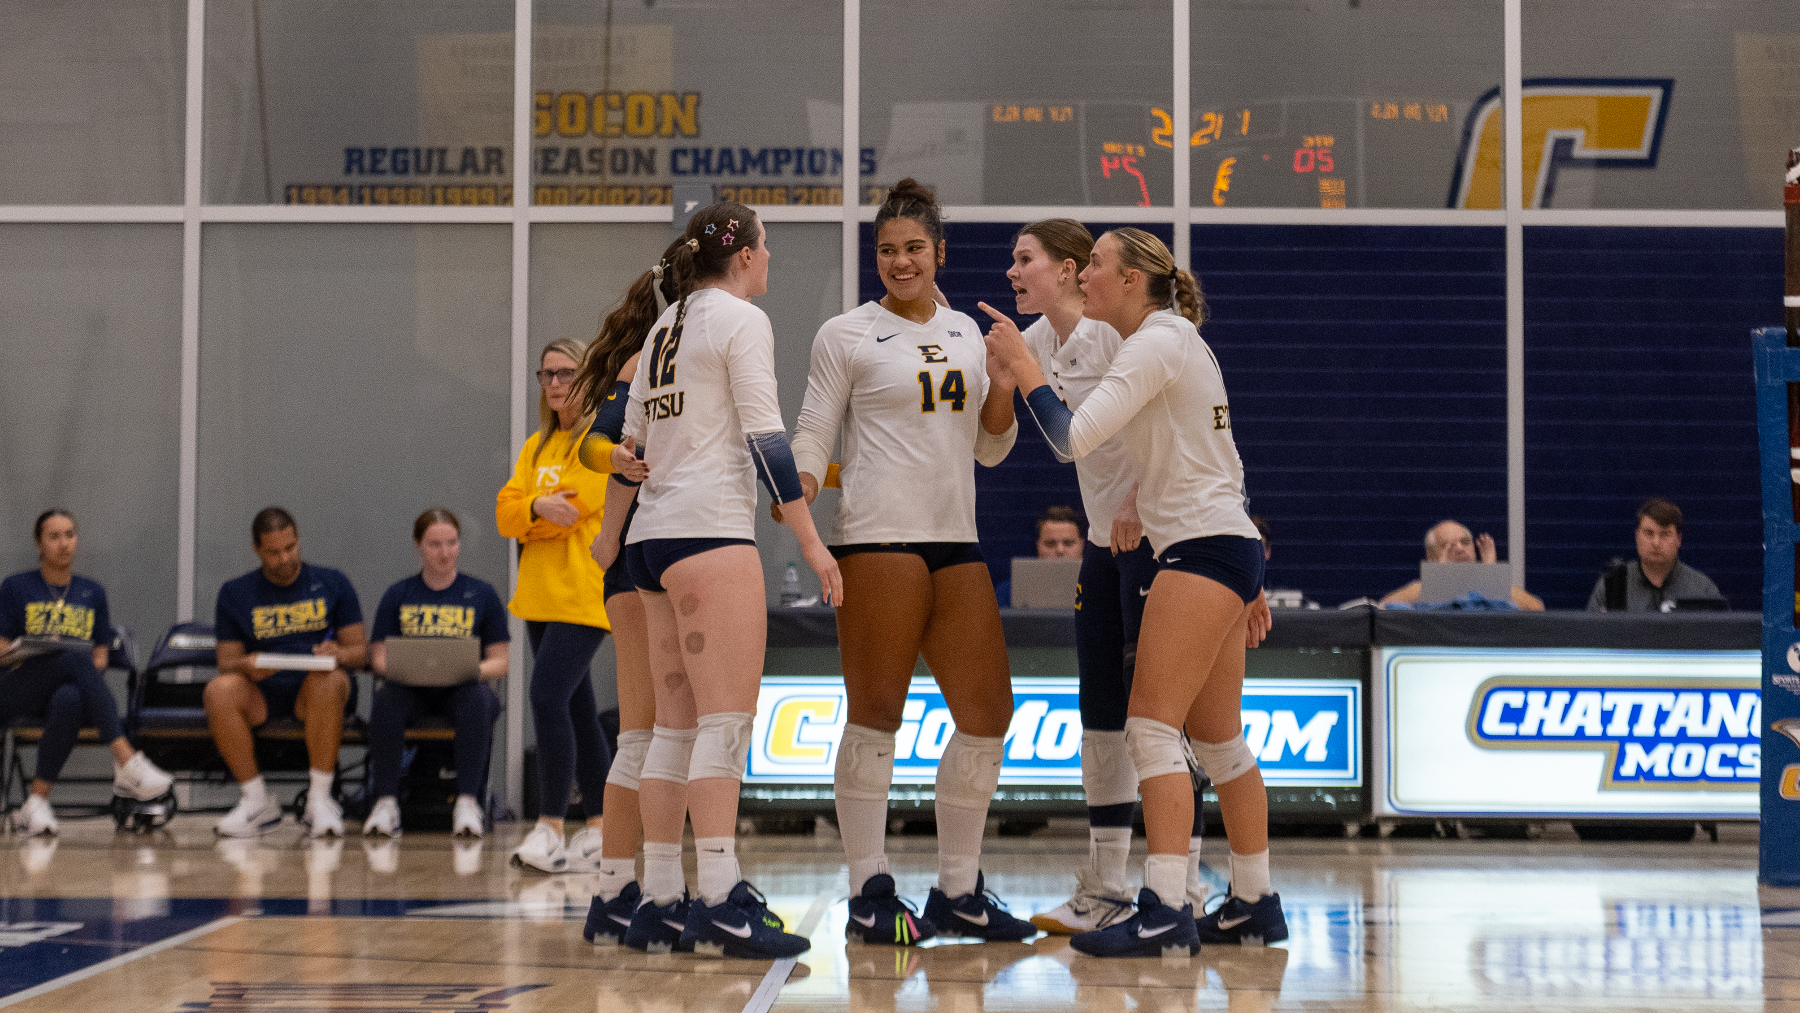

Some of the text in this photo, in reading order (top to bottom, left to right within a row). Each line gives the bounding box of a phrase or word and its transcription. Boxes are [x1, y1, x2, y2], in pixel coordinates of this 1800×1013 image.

[534, 90, 702, 138] SOCON
[344, 147, 504, 175] REGULAR
[533, 147, 657, 176] EASON
[648, 325, 684, 391] 12
[917, 369, 968, 413] 14
[251, 598, 328, 630] ETSU
[399, 604, 475, 629] ETSU
[1482, 690, 1761, 737] CHATTAN
[1620, 742, 1761, 777] MOCS
